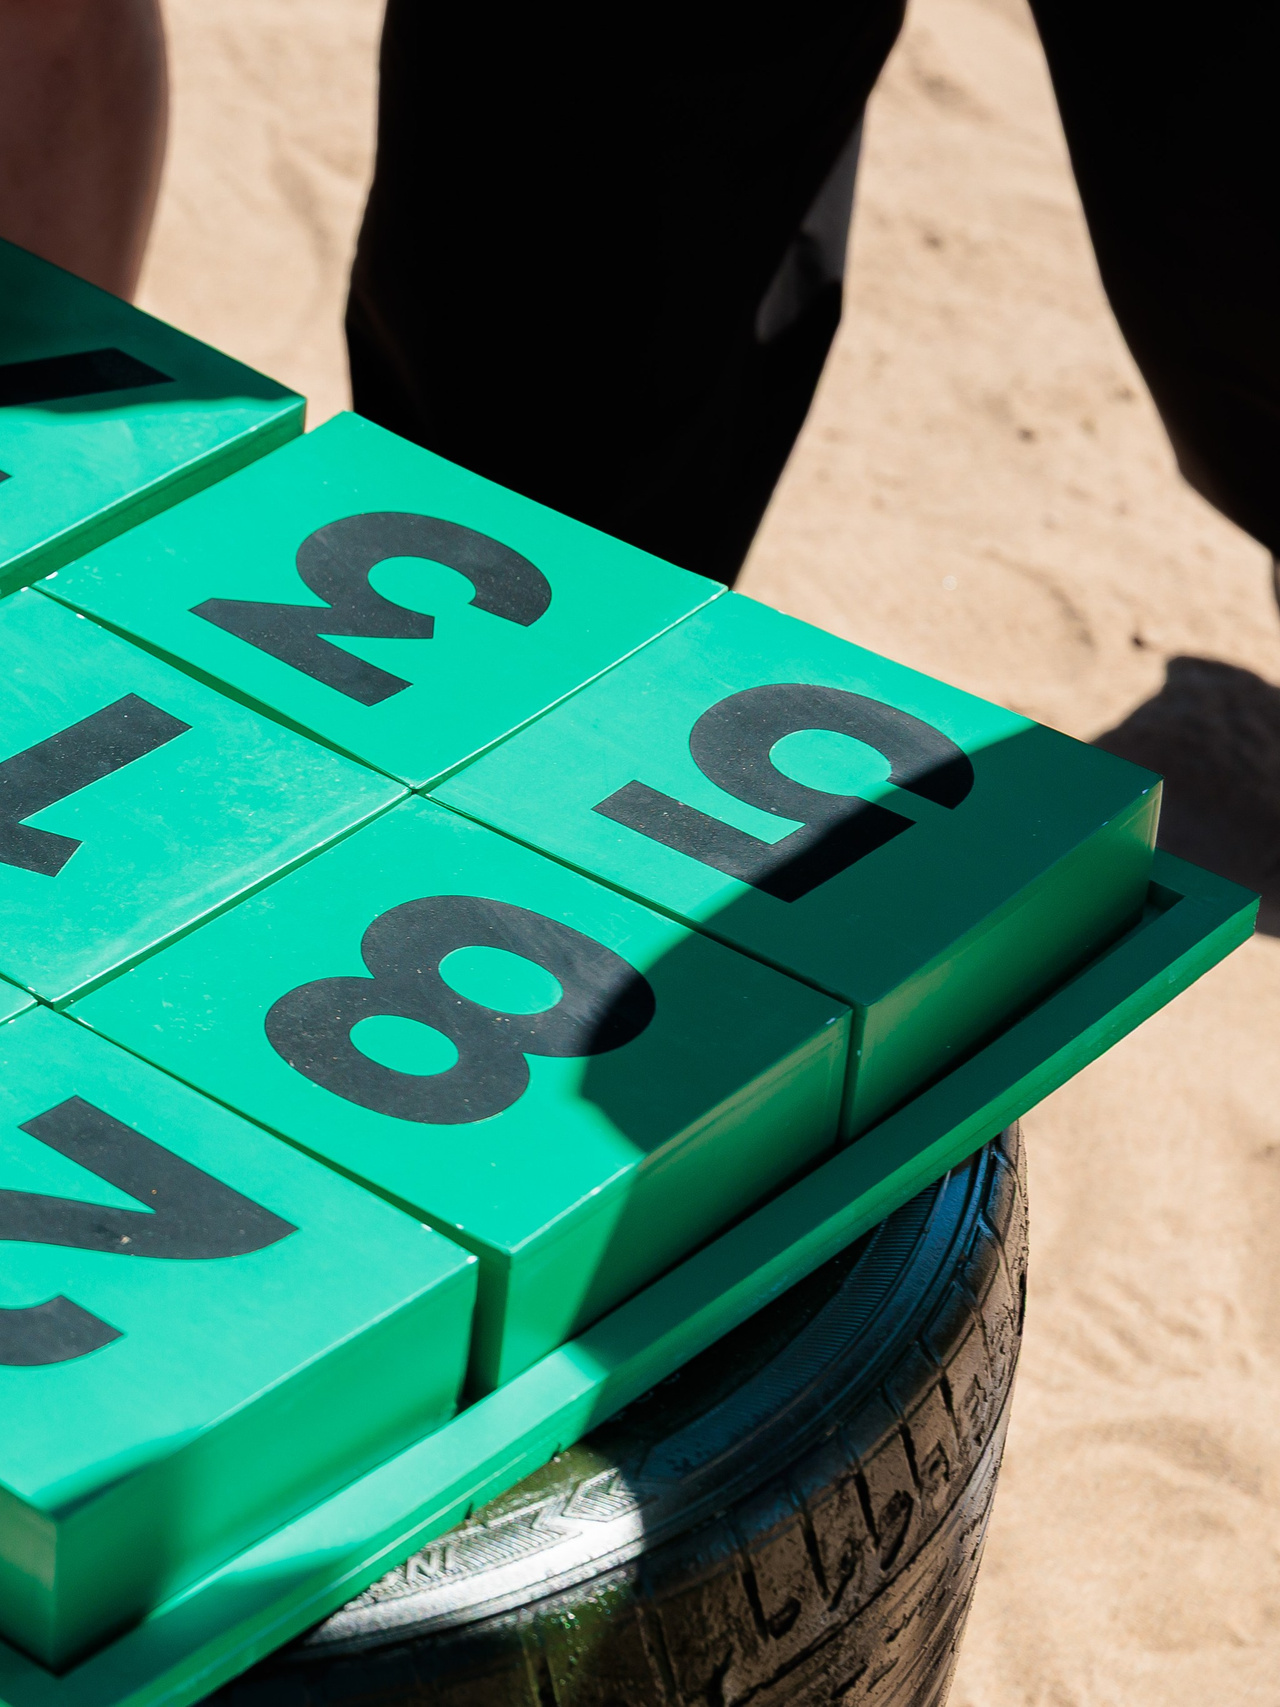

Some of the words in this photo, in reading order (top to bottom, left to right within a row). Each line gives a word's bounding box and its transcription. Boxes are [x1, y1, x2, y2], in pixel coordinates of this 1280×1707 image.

[191, 511, 553, 706] 3
[592, 683, 976, 903] 5
[265, 894, 657, 1125] 8
